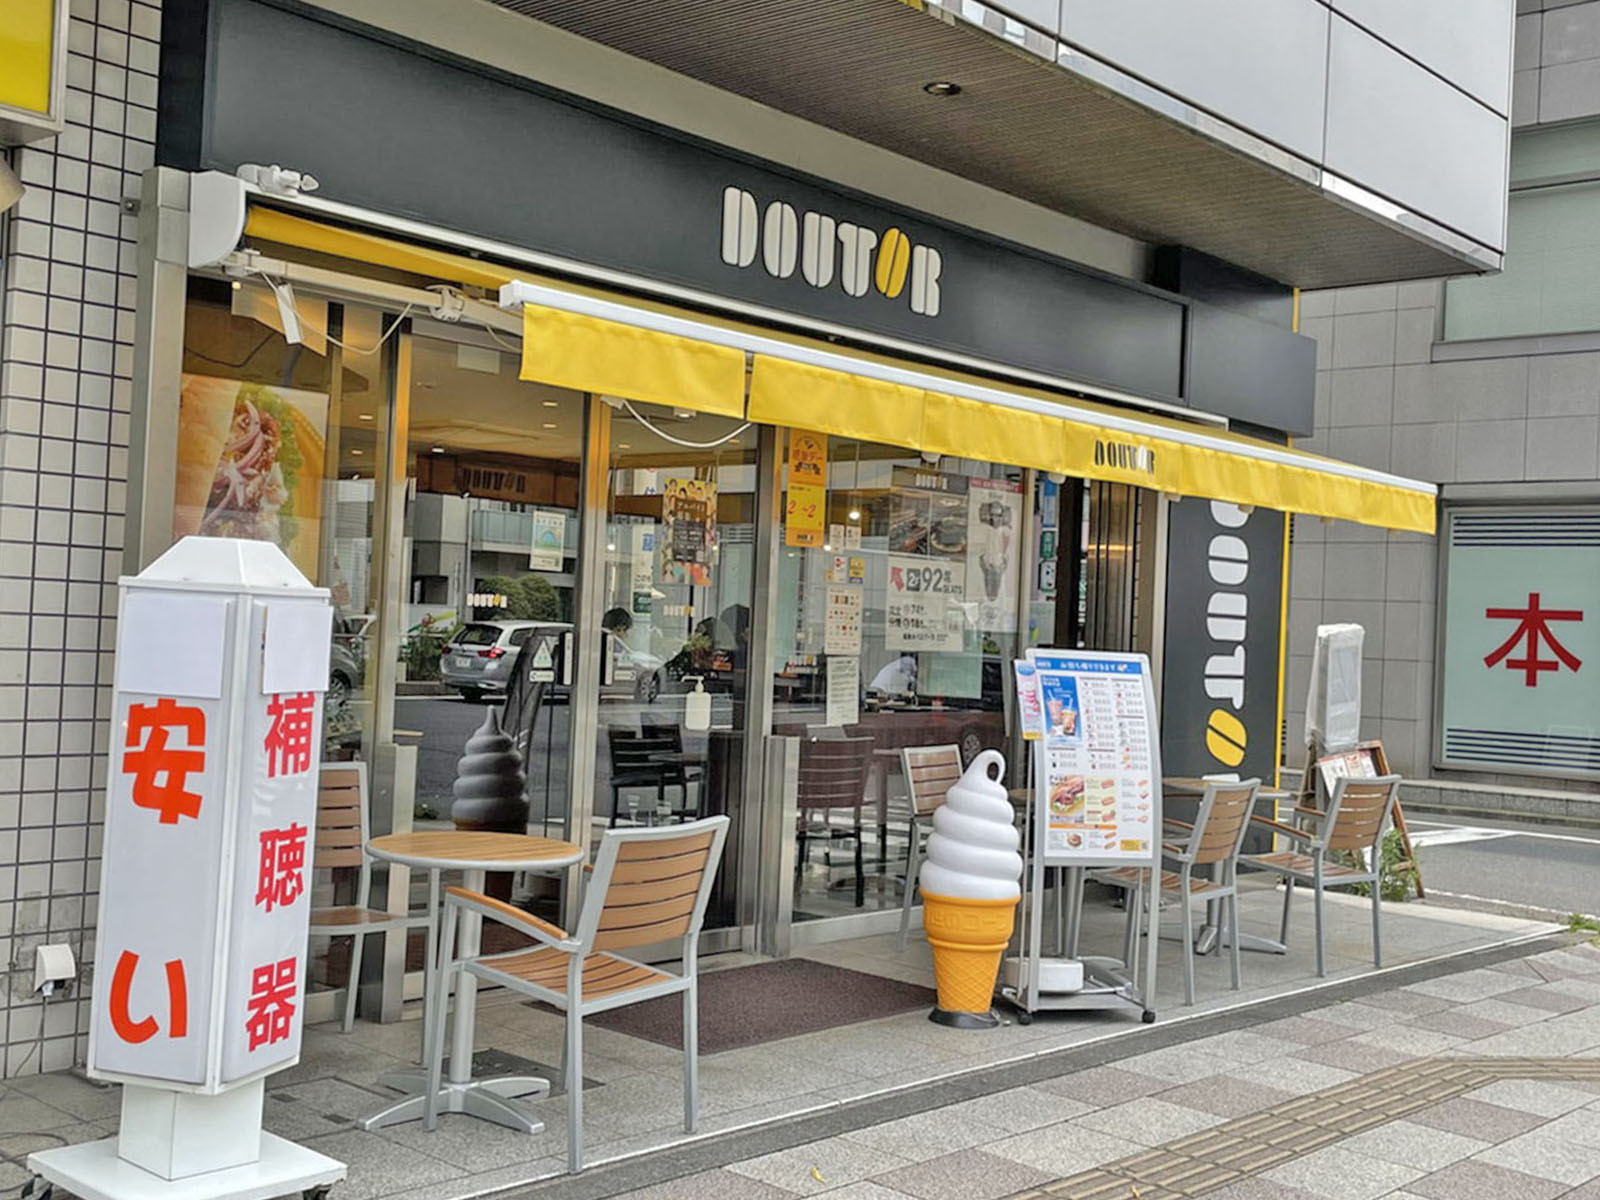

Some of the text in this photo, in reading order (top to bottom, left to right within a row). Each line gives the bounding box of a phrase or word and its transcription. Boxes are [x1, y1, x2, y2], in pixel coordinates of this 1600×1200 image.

[721, 186, 943, 318] DOUTOR
[1094, 439, 1156, 475] DOUTOR
[922, 567, 943, 592] 92
[1484, 592, 1584, 688] 本
[109, 697, 206, 1044] 安い
[245, 692, 317, 1053] 補聴器
